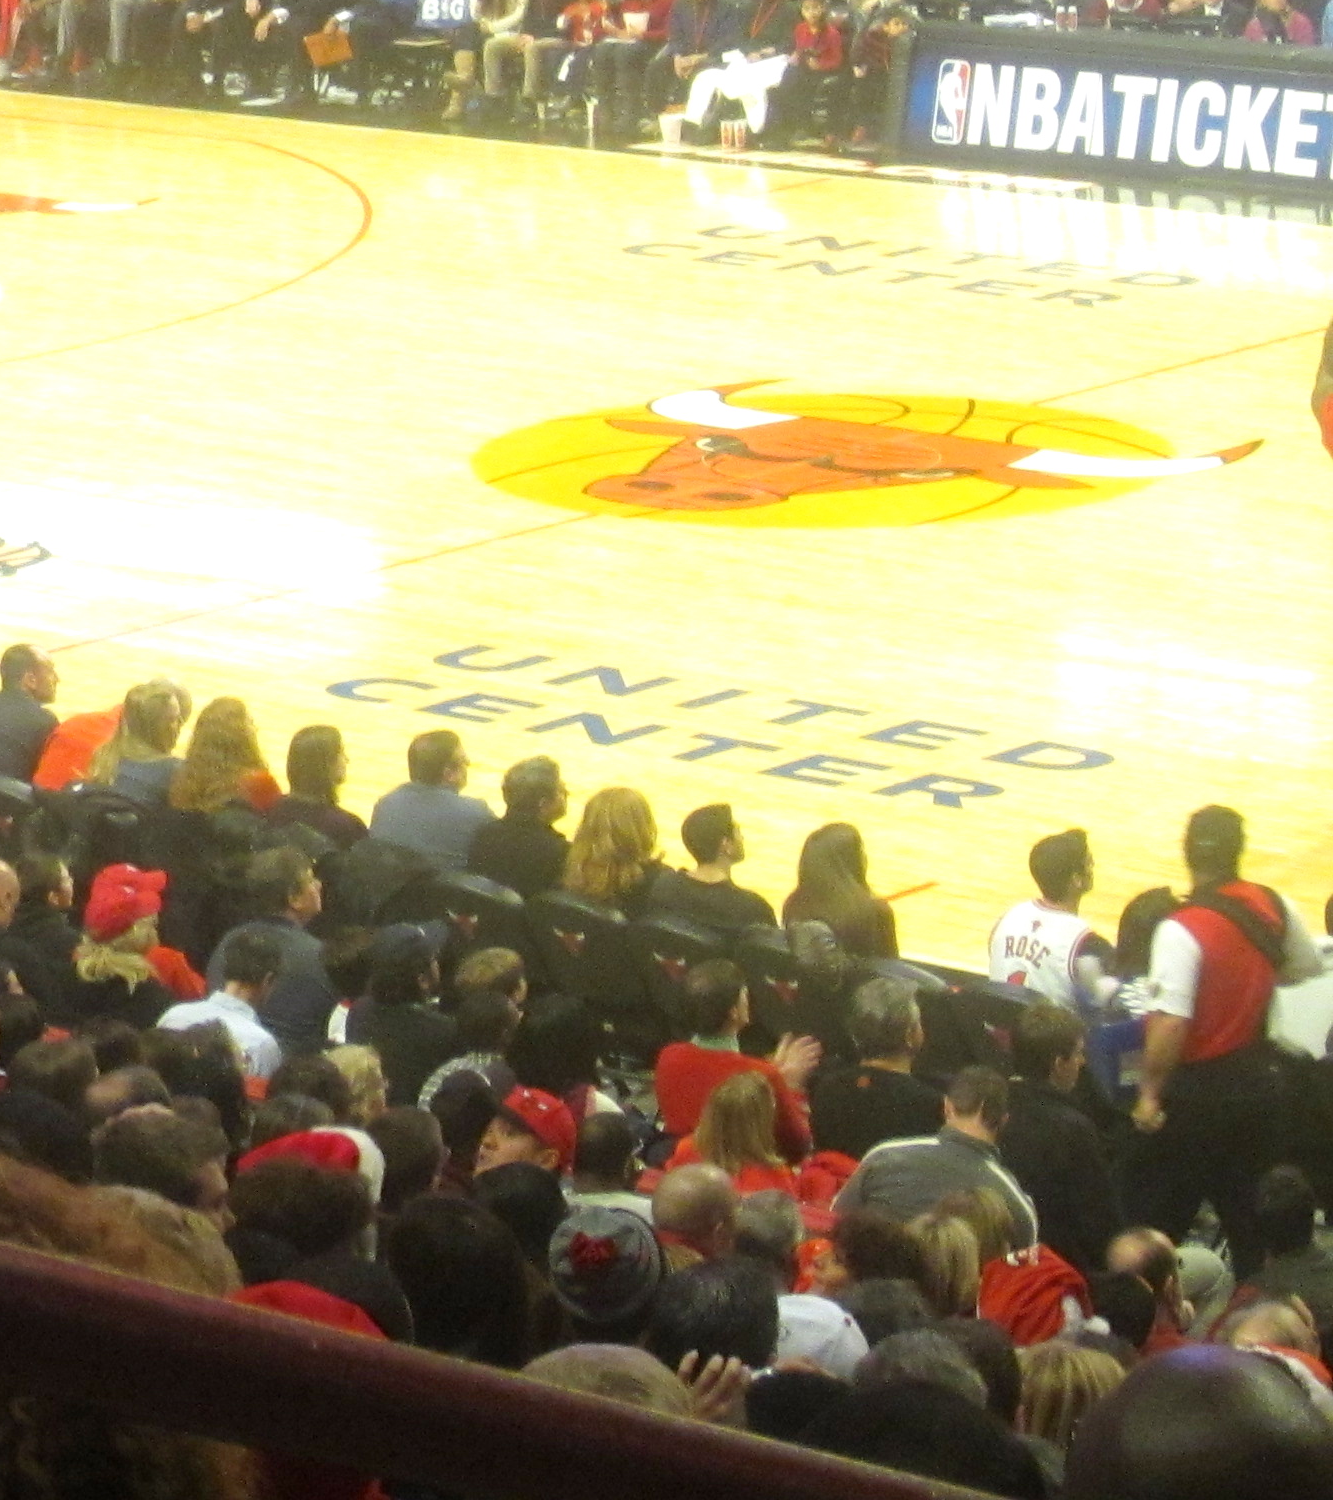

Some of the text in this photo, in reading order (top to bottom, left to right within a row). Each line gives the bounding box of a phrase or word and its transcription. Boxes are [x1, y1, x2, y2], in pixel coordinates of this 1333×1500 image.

[966, 62, 1333, 180] NBATICKE
[620, 243, 1122, 308] CENTER
[696, 225, 1200, 287] UNITED
[325, 678, 1006, 809] CENTER
[433, 644, 1115, 771] UNITED
[1004, 934, 1051, 969] ROSE
